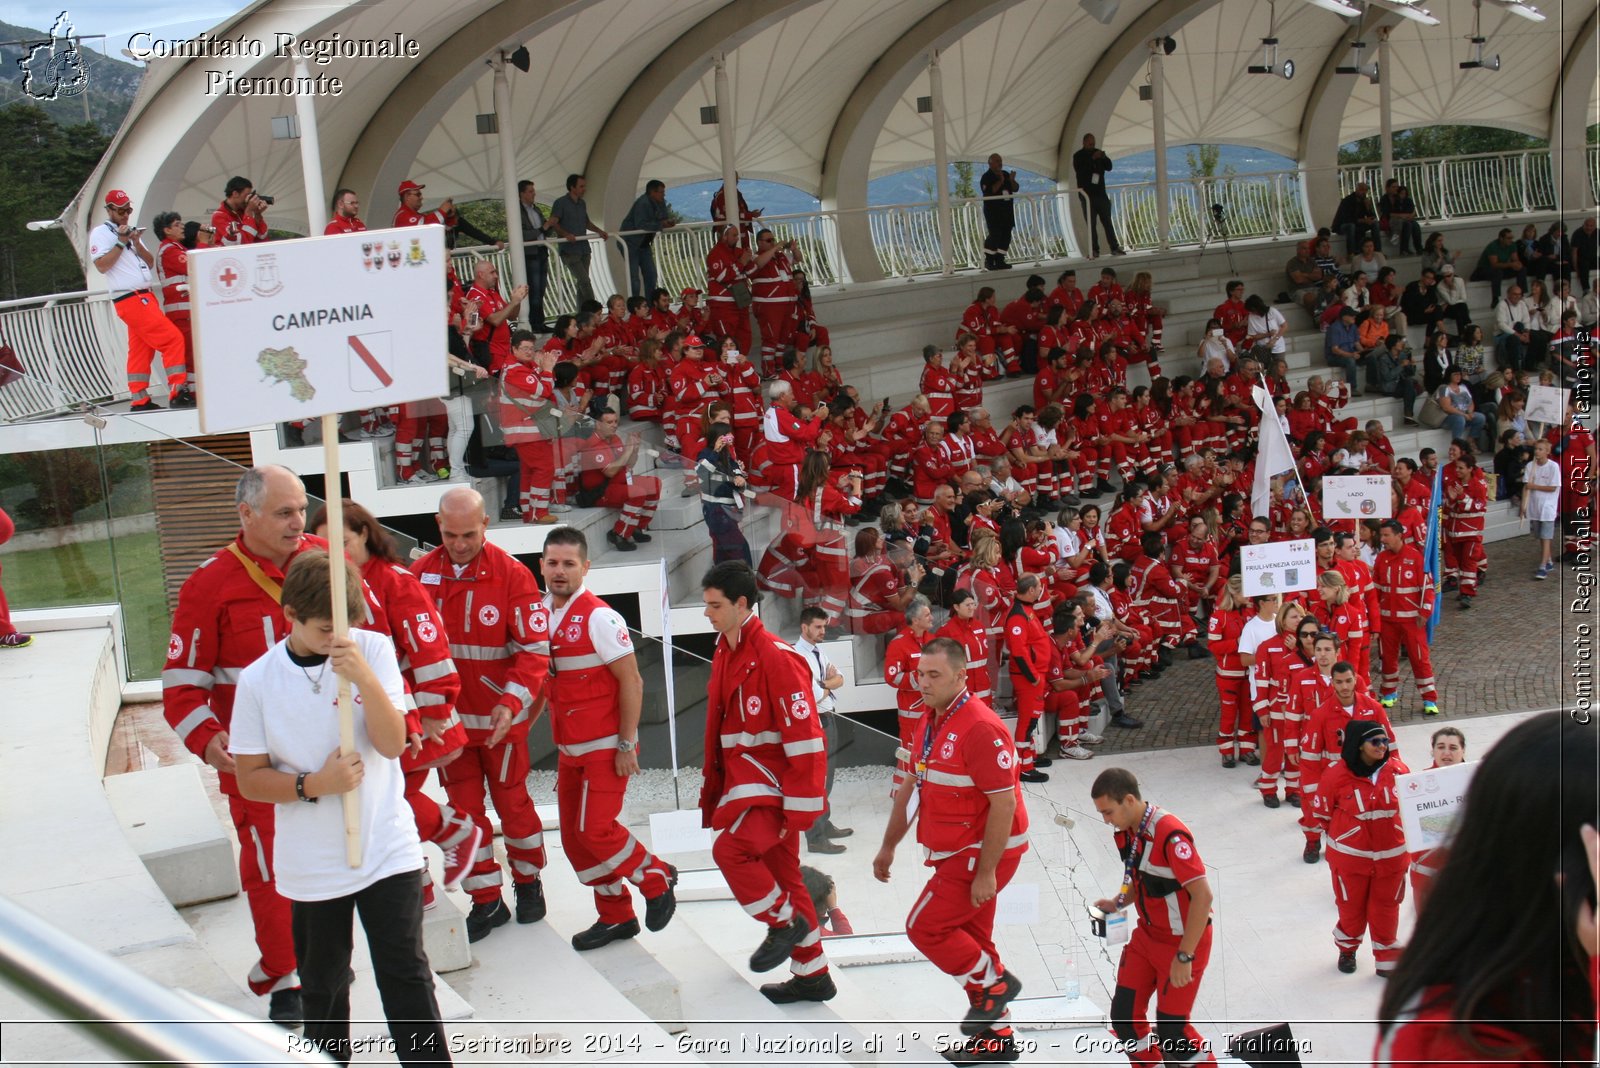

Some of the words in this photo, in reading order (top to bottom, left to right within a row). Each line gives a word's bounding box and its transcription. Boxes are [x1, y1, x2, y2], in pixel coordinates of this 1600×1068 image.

[272, 303, 374, 332] CAMPANIA
[1245, 561, 1291, 572] FRIULI-VENEZIA
[1291, 559, 1311, 567] GIULIA
[1416, 798, 1449, 812] EMILIA
